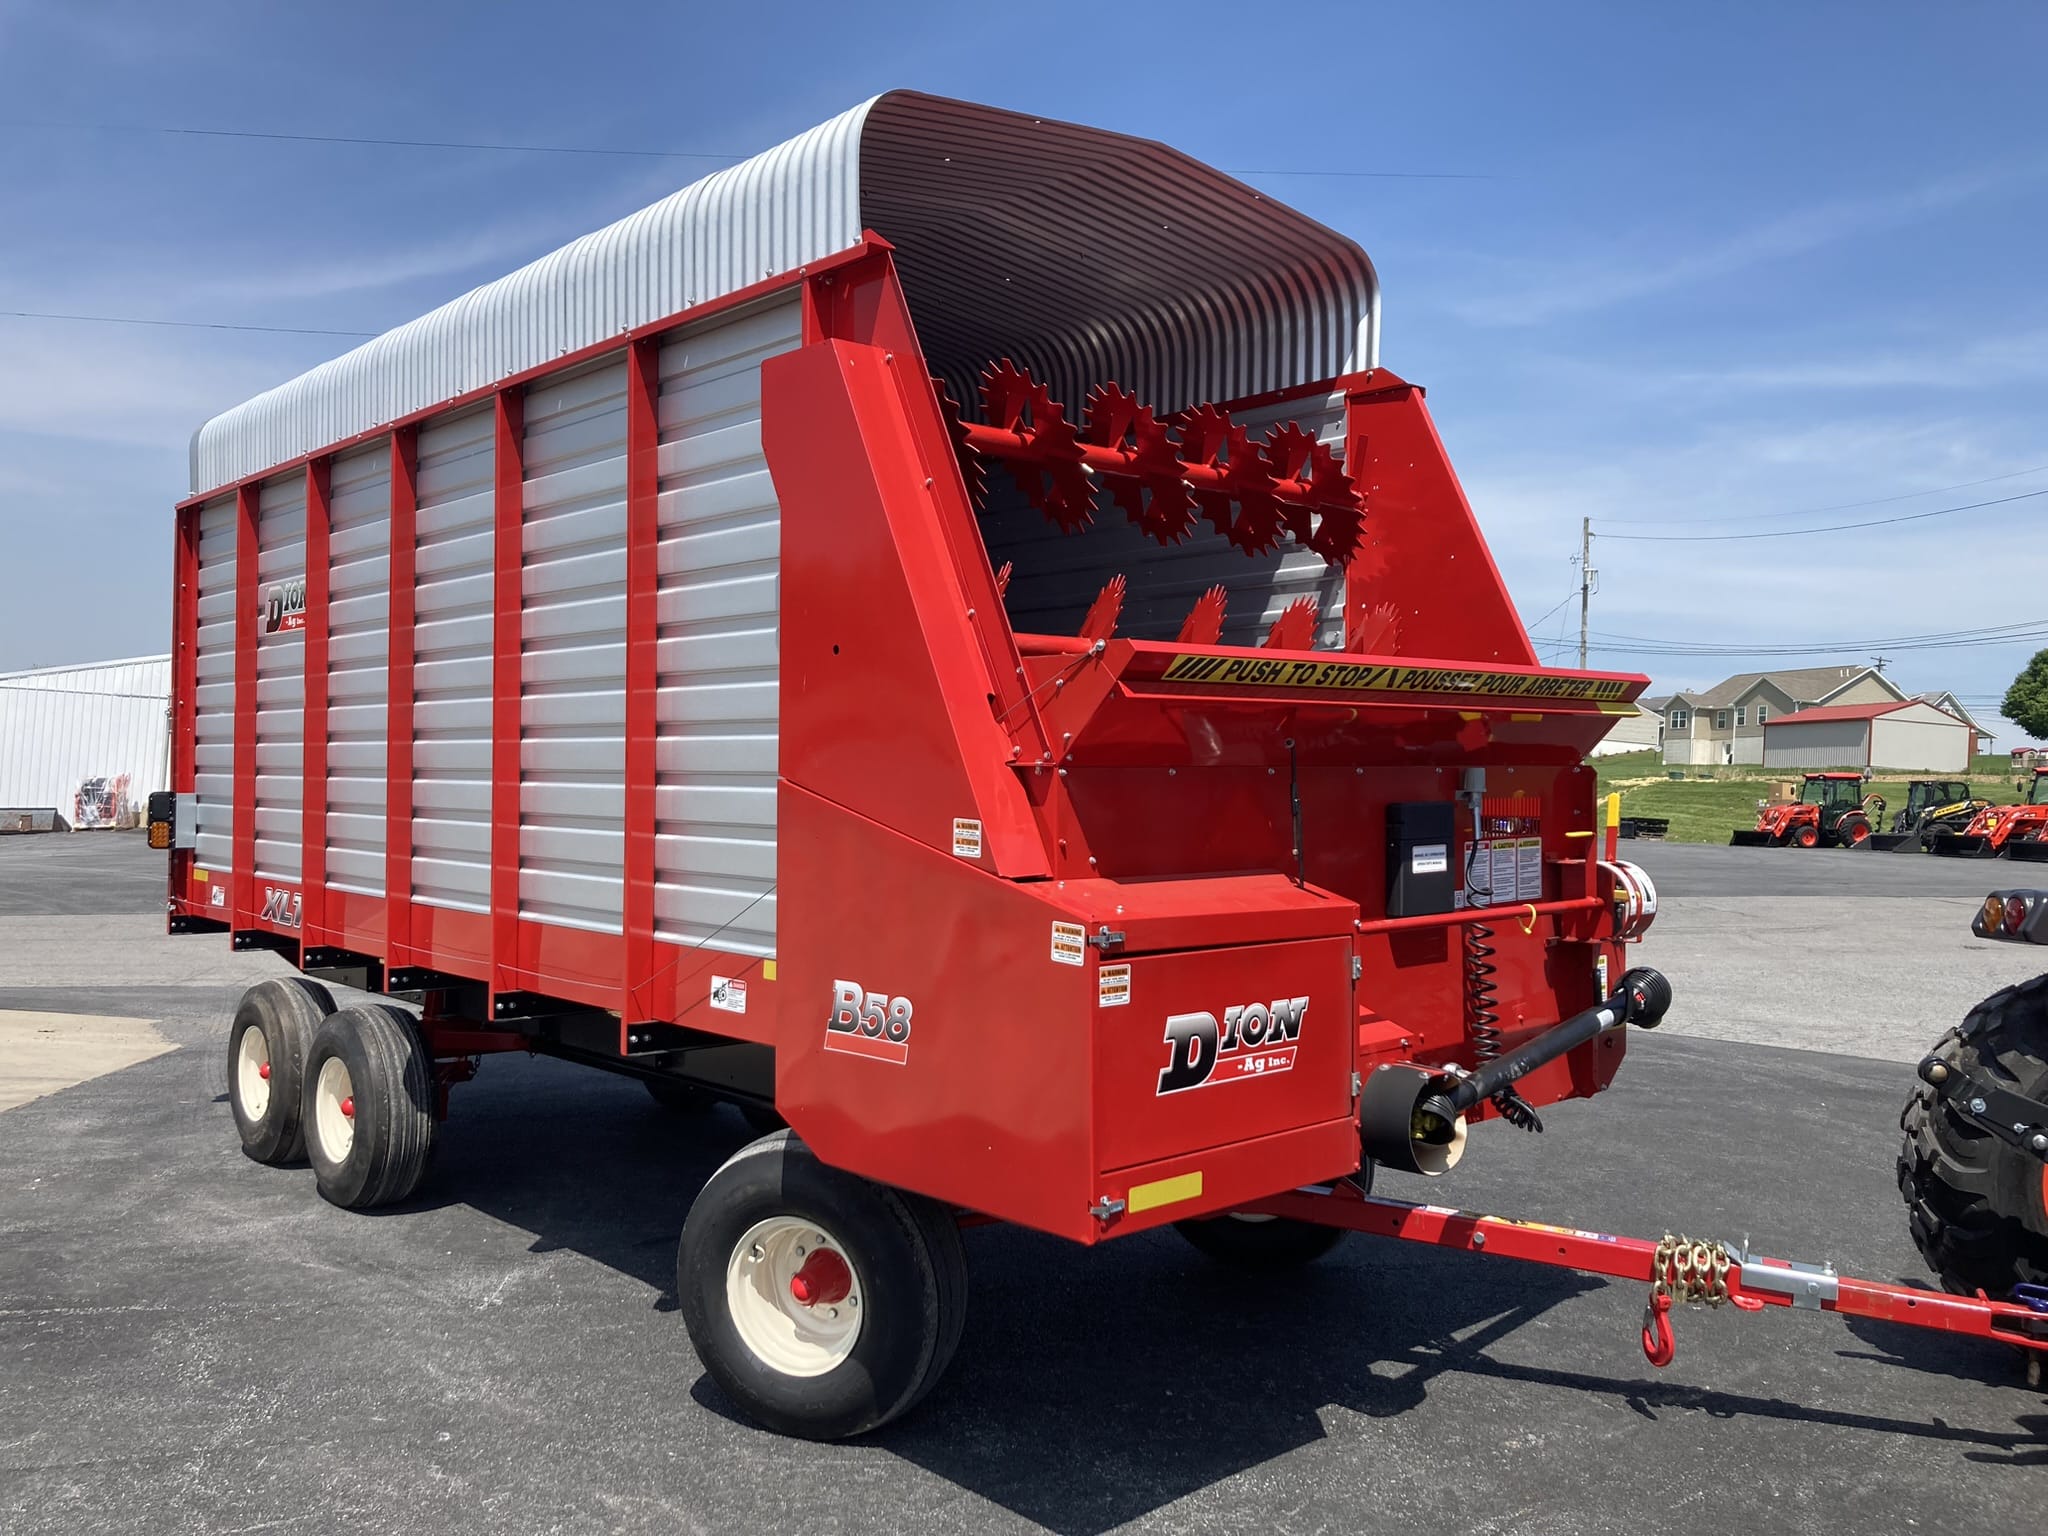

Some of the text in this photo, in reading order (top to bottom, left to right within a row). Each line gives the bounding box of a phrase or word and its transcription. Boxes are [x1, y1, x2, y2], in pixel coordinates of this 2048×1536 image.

[1220, 659, 1290, 683] PUSH
[1285, 663, 1318, 685] TO
[1315, 664, 1373, 687] STOP
[1397, 669, 1483, 691] POUSSEZ
[1475, 674, 1527, 694] POUR
[828, 979, 913, 1043] B58
[1156, 996, 1310, 1096] DION
[1268, 1055, 1290, 1067] Inc.
